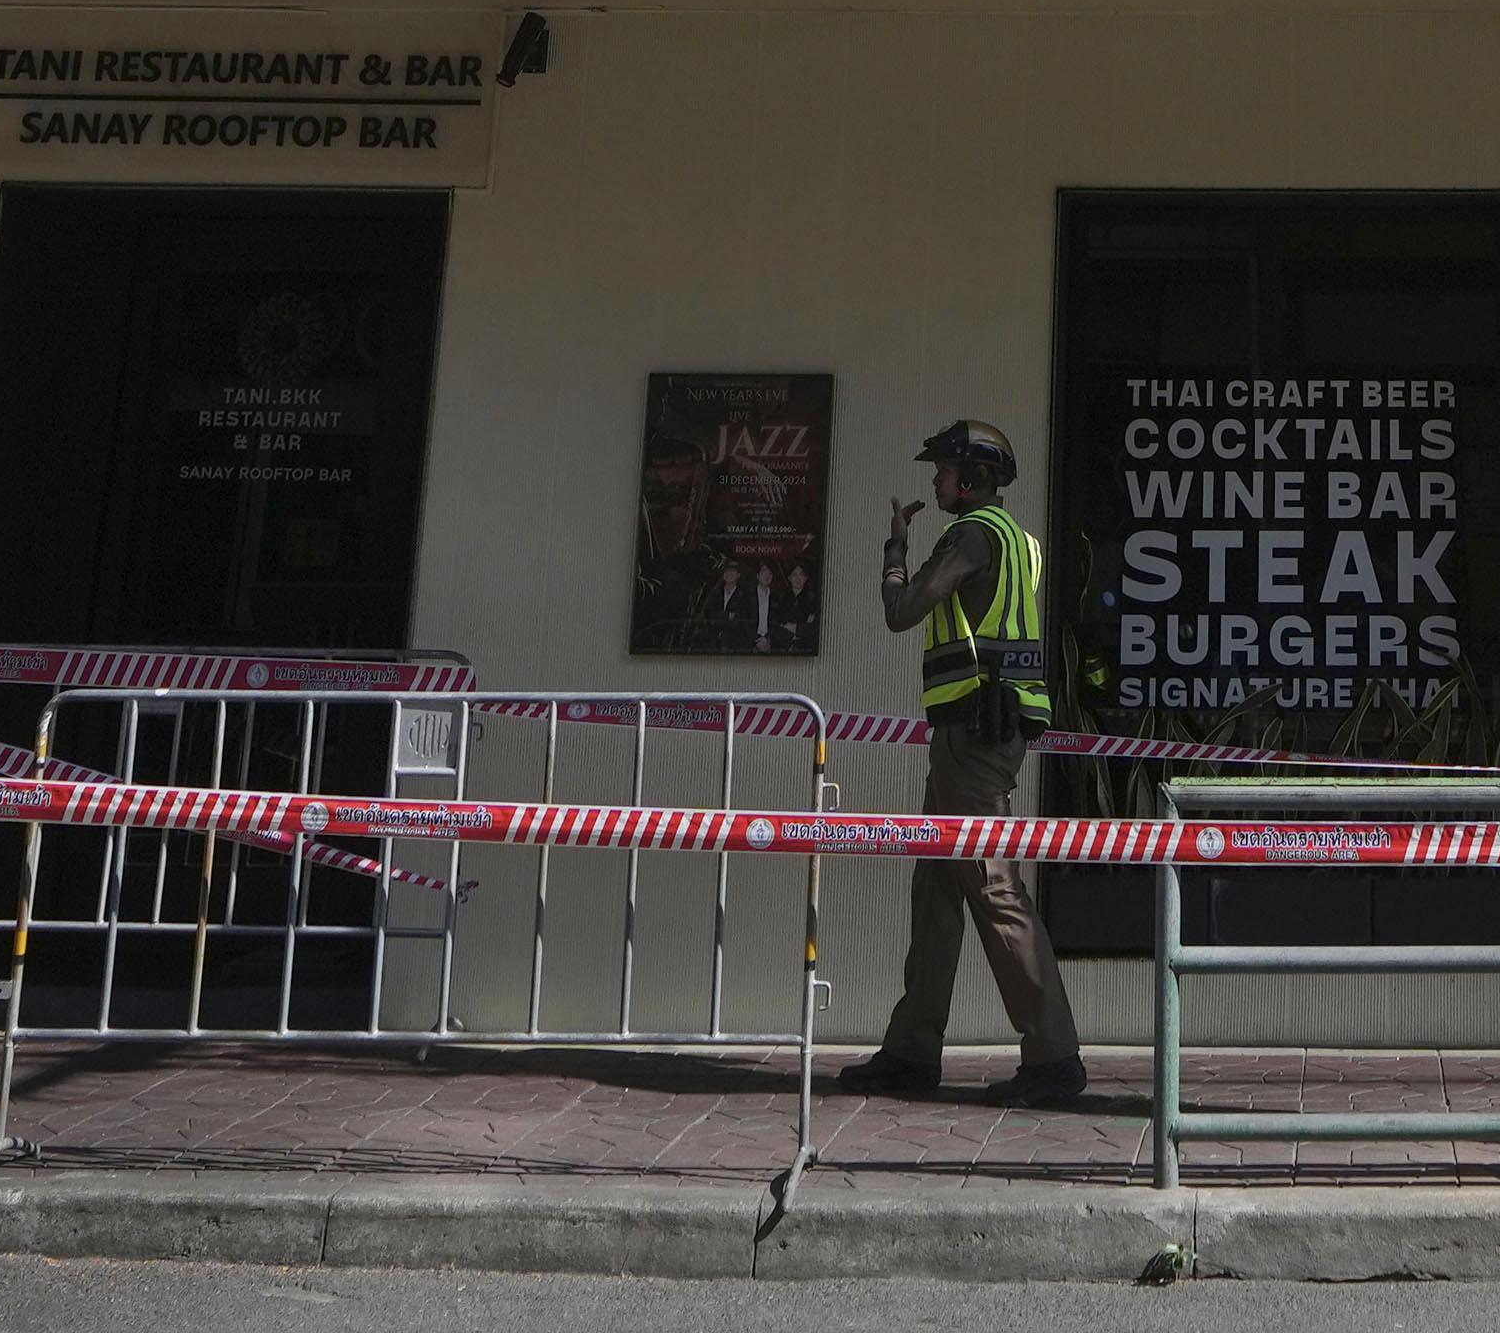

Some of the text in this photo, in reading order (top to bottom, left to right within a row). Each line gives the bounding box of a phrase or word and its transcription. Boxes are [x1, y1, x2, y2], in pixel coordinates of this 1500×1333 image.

[94, 50, 350, 85] RESTAURANT
[358, 54, 392, 86] &
[404, 55, 484, 88] BAR
[19, 113, 439, 149] SANAY ROOFTOP BAR
[223, 388, 323, 406] TANI.BKK
[686, 386, 718, 402] NEW
[1126, 379, 1457, 408] THAI CRAFT BEER
[198, 410, 342, 428] RESTAURANT
[233, 433, 302, 451] & BAR
[710, 423, 811, 464] JAZZ
[1124, 418, 1456, 461] COCKTAILS
[179, 465, 353, 482] SANAY ROOFTOP BAR
[1124, 470, 1459, 519] WINE BAR
[1121, 528, 1459, 604] STEAK
[1119, 613, 1462, 667] BURGERS
[1002, 652, 1041, 667] POL
[335, 801, 493, 830] เขตอันตรายห้ามเข้า
[781, 818, 940, 842] เขตอันตรายห้ามเข้า
[1231, 826, 1391, 849] เขตอันตรายห้ามเข้า
[1266, 850, 1359, 861] DANGEROUS AREA
